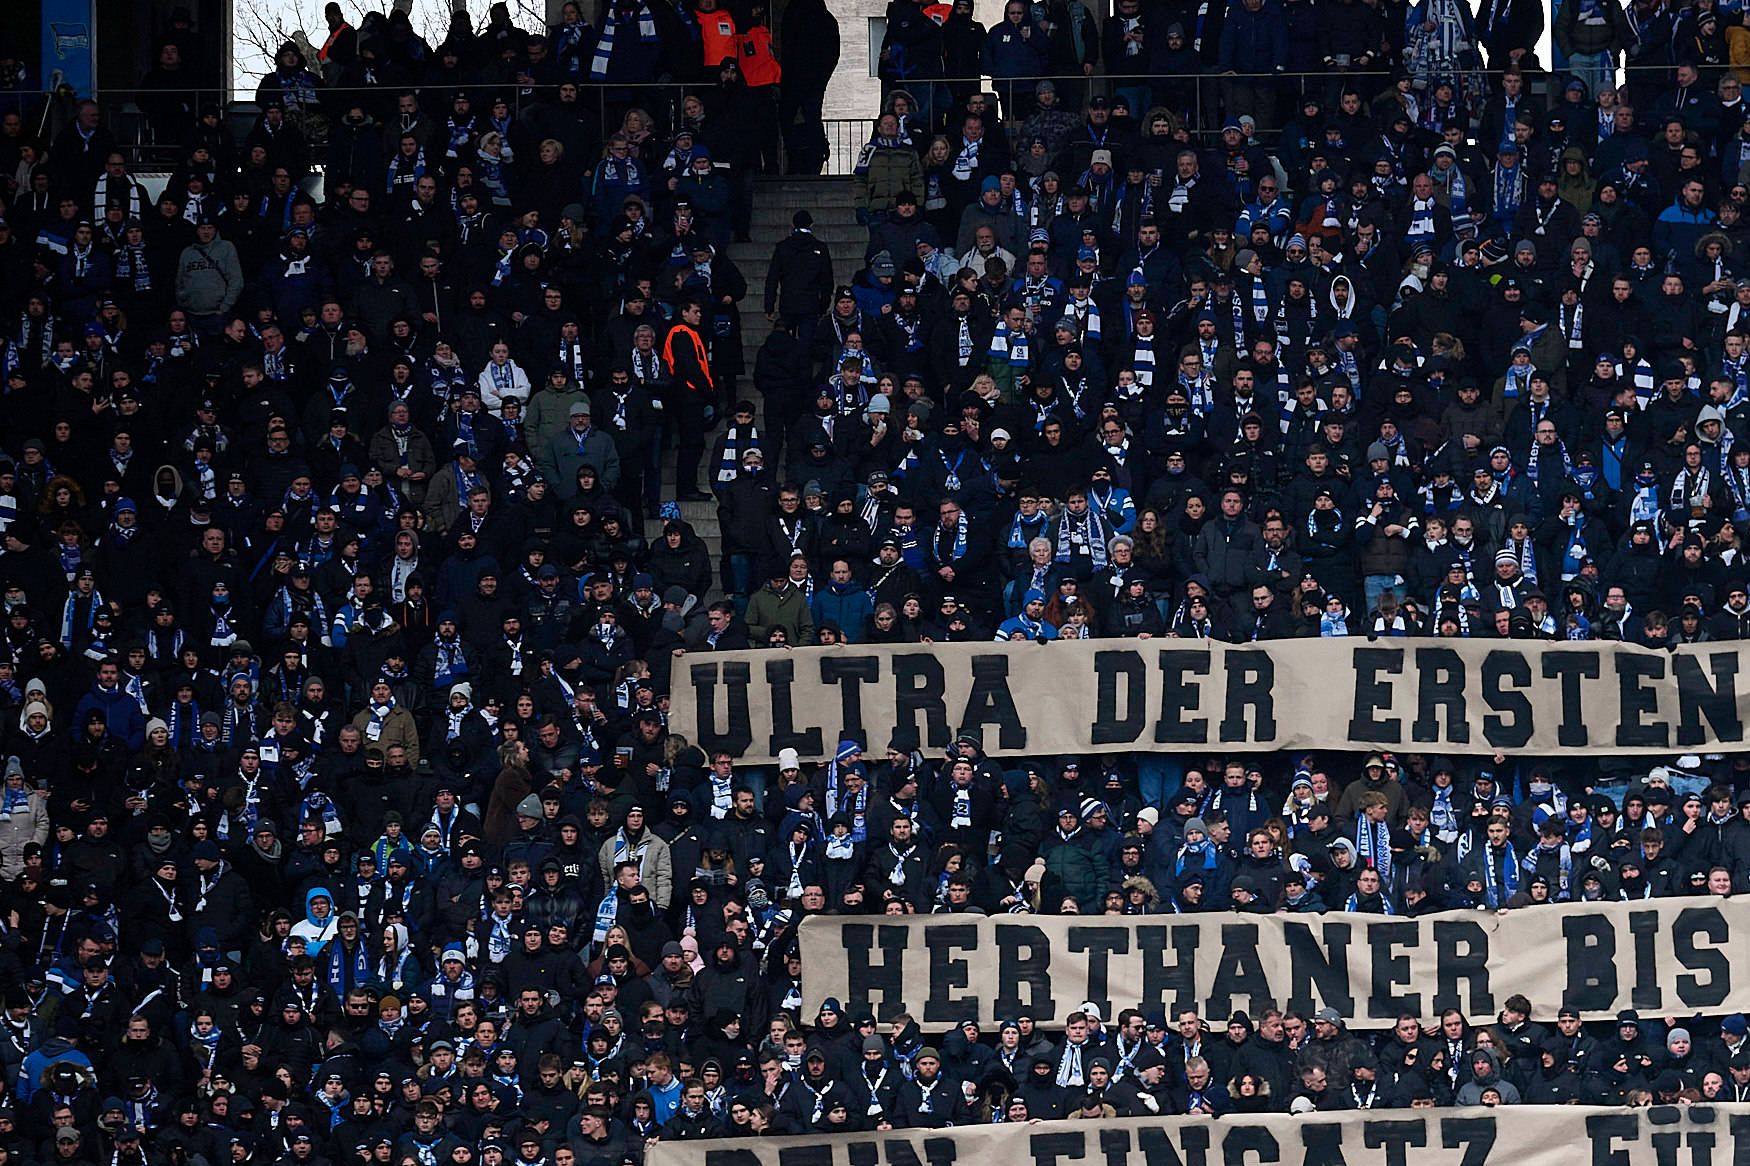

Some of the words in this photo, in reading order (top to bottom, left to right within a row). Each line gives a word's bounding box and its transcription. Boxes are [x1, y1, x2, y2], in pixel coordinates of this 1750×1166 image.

[690, 652, 1027, 757] ULTRA
[1090, 649, 1276, 744] DER
[1349, 647, 1743, 748] ERSTEN
[841, 921, 1494, 1027] HERTHANER
[1562, 908, 1731, 1011] BIS
